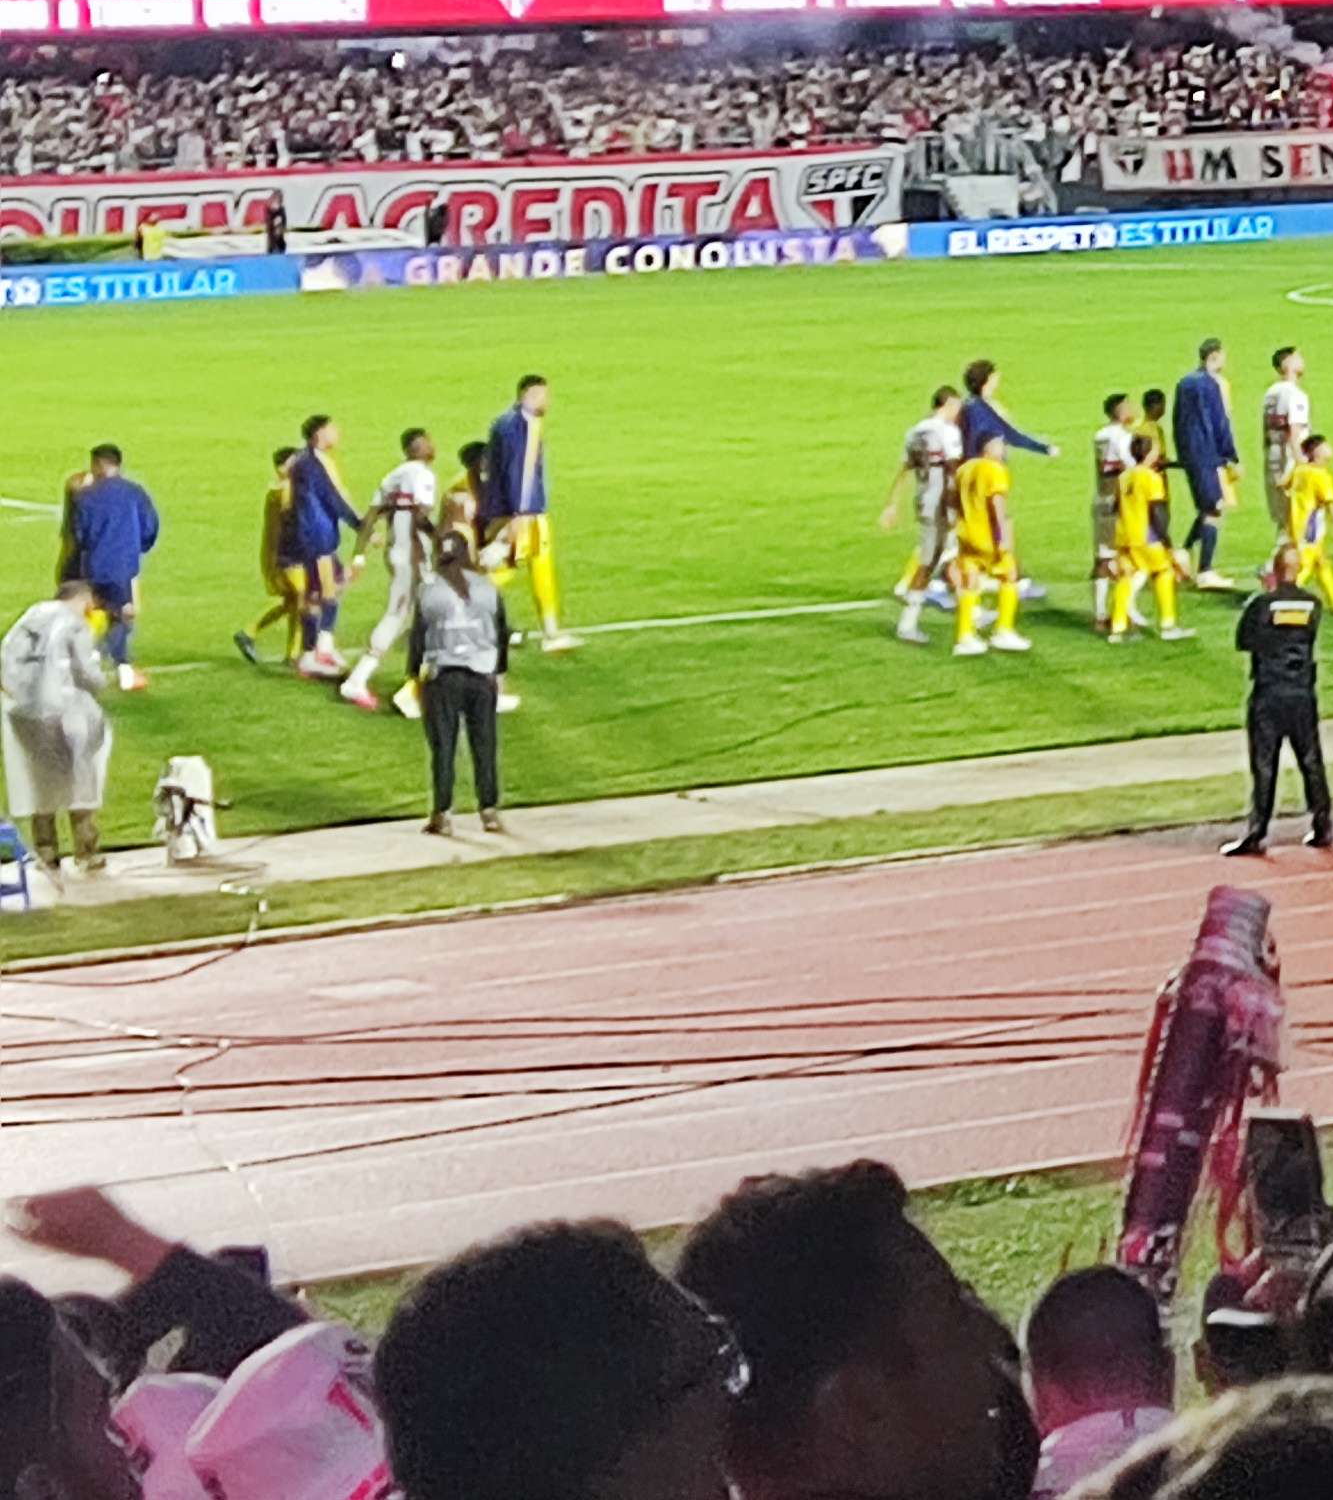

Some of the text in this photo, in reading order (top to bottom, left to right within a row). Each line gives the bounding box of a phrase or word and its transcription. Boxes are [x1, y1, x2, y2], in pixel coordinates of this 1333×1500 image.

[806, 161, 885, 193] SPFC
[1165, 146, 1237, 182] UM
[314, 169, 783, 246] ACREDITA
[948, 229, 986, 256] EL
[1119, 223, 1157, 248] ES
[1159, 215, 1274, 243] TITULAR
[406, 247, 587, 286] GRANDE
[604, 237, 856, 274] CONQUISTA
[45, 277, 88, 302] ES
[92, 269, 237, 299] TITULAR
